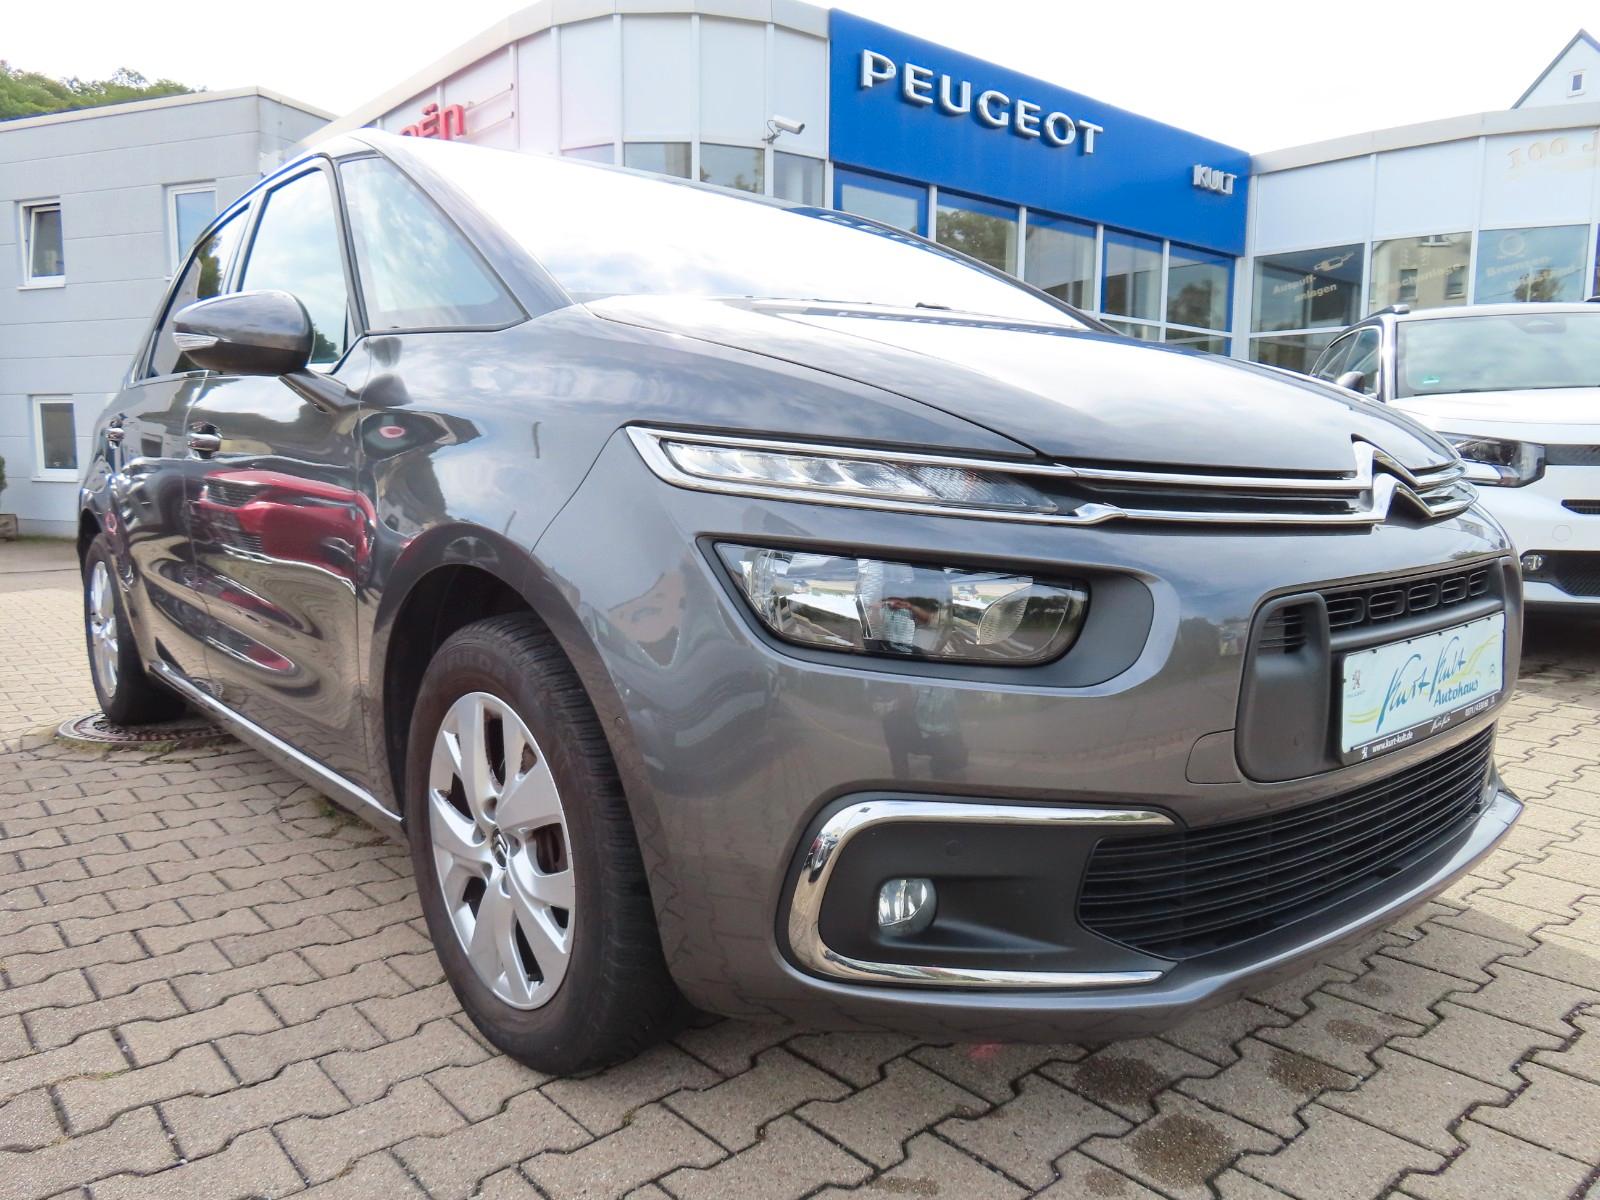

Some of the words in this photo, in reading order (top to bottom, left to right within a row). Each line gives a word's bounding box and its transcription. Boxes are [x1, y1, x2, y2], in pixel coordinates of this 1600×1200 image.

[860, 48, 1104, 156] PEUGEOT
[1192, 163, 1238, 196] KULT
[1433, 679, 1479, 709] Autohaus
